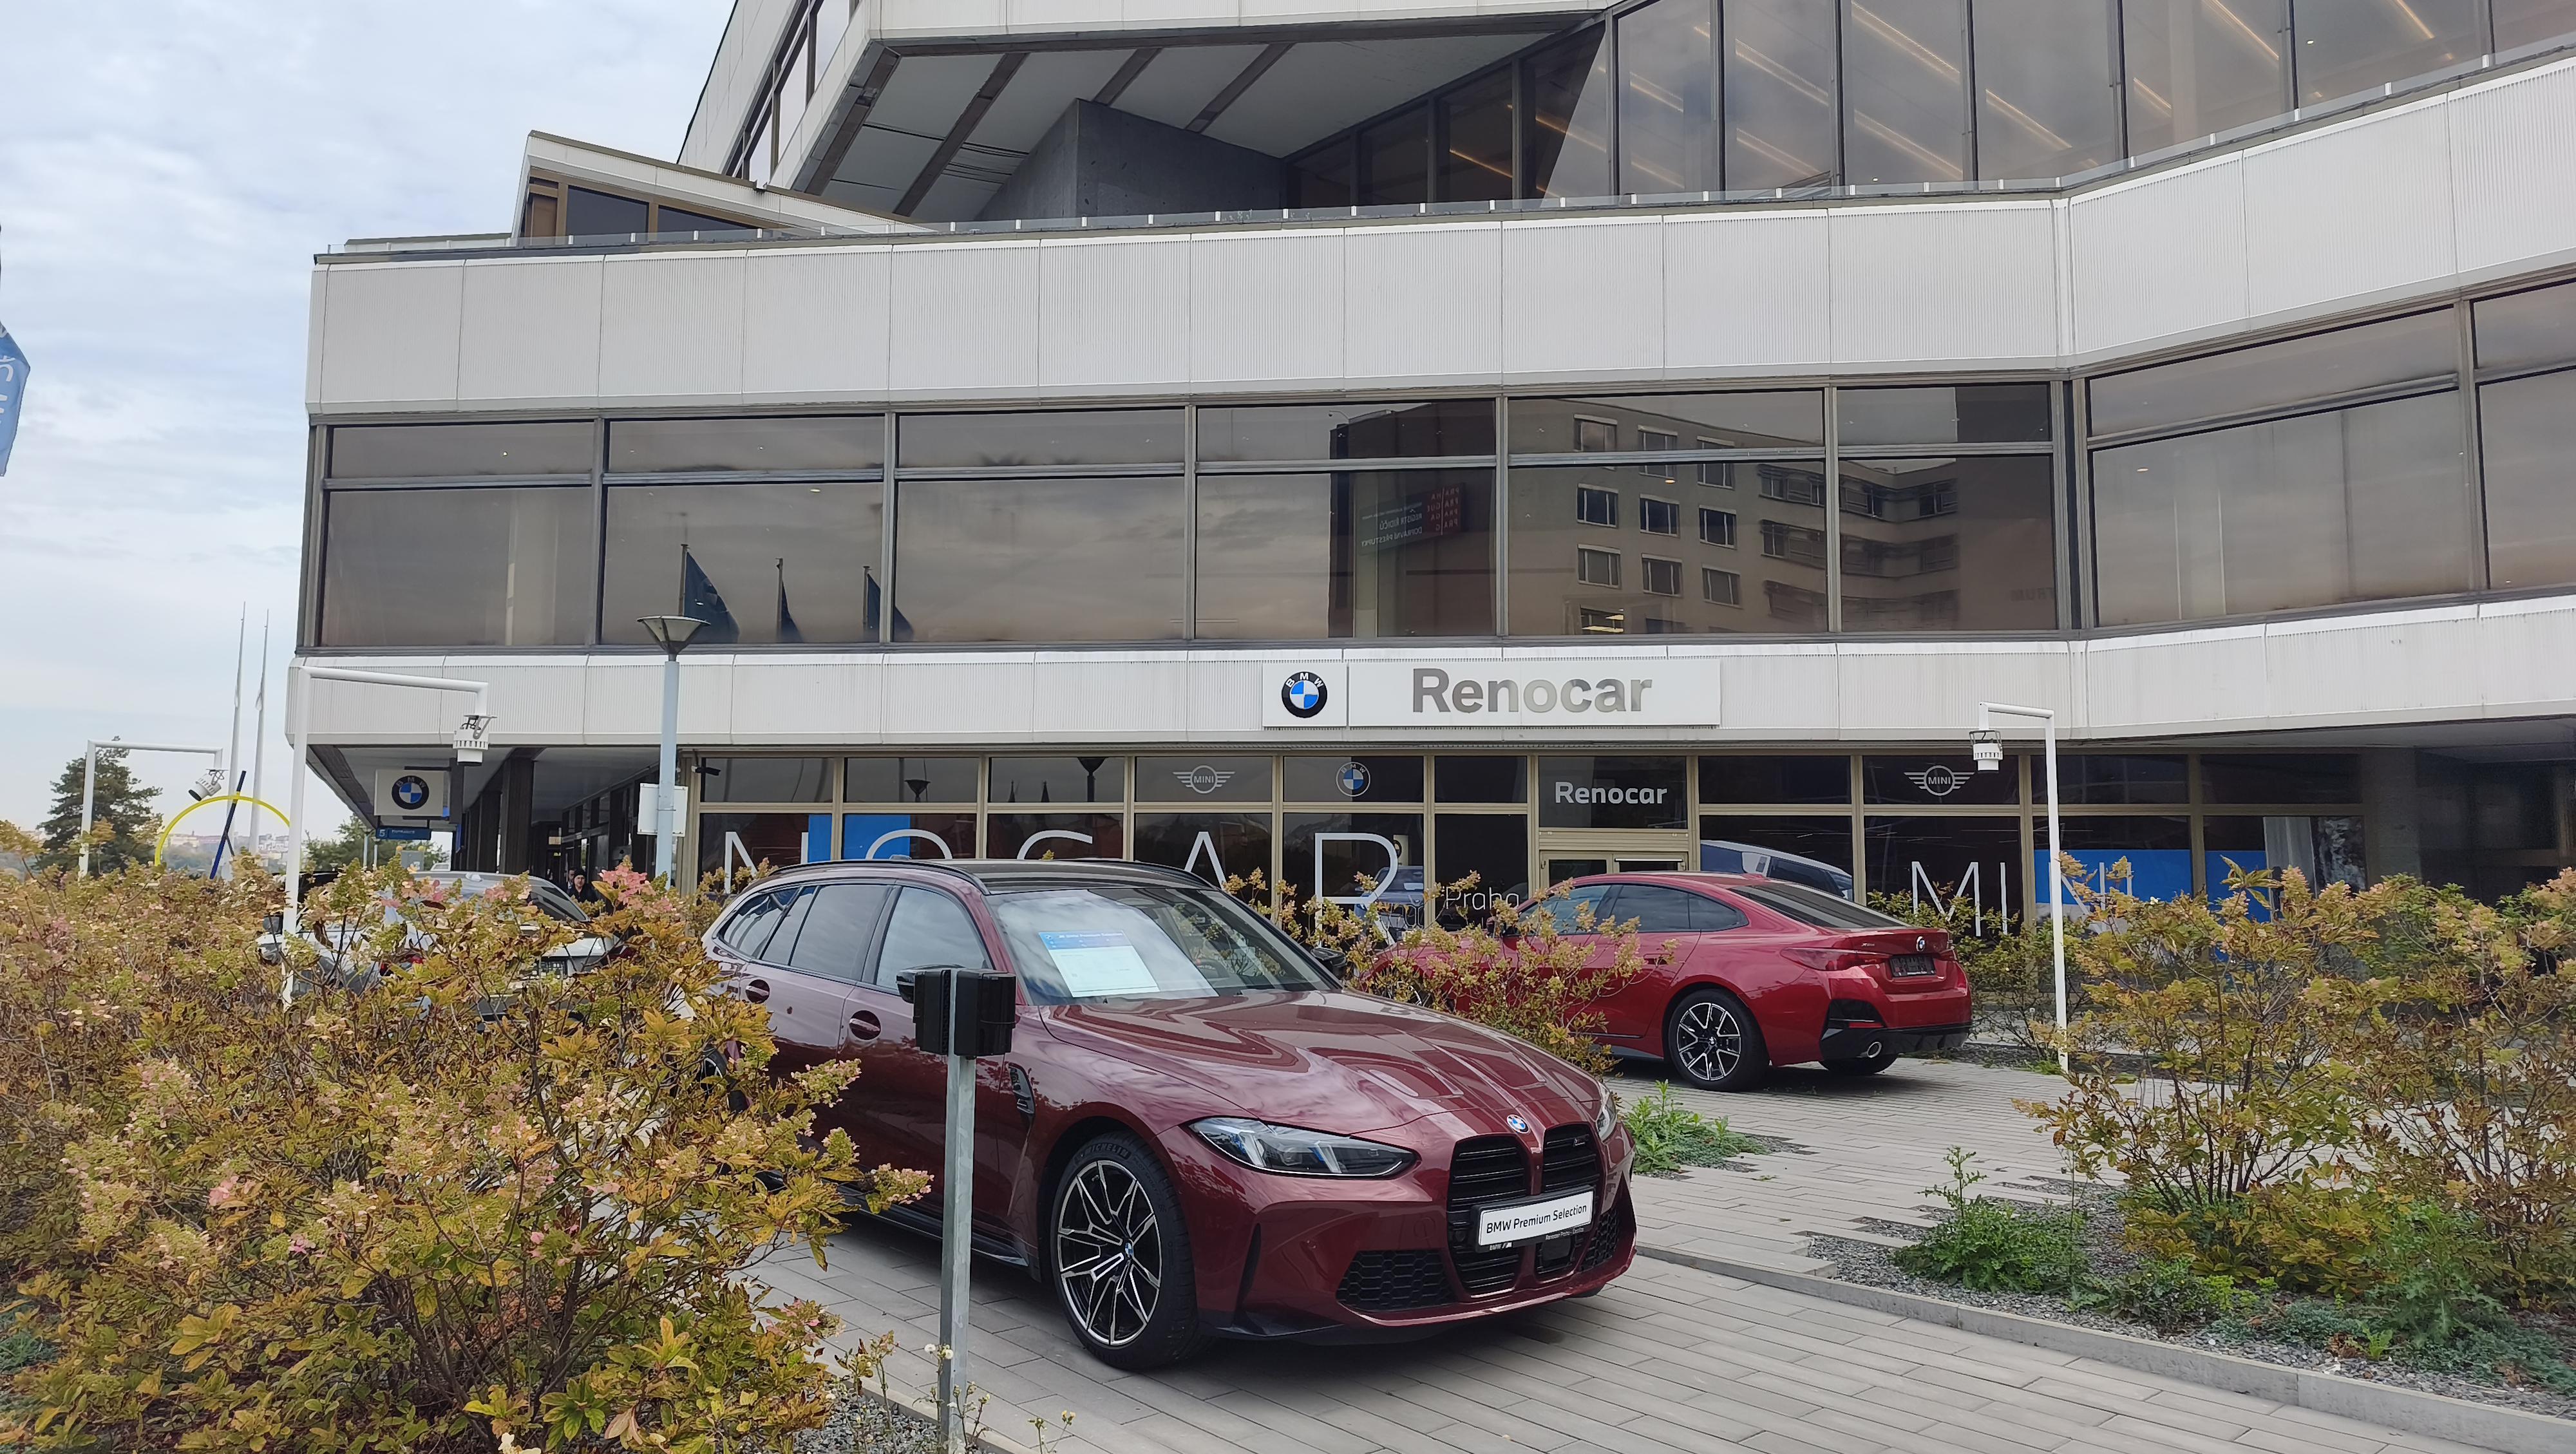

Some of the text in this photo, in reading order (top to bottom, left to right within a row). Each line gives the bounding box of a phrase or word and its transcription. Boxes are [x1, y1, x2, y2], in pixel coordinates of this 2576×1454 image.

[1285, 672, 1324, 688] BMW
[1412, 668, 1653, 714] Renocar
[1341, 764, 1367, 775] BMW
[396, 776, 426, 789] BMW
[1193, 775, 1214, 784] MINI
[1555, 781, 1668, 805] Renocar
[1445, 885, 1520, 911] Praha
[1084, 1143, 1130, 1158] MICHELIN
[1486, 1204, 1587, 1234] BMW Premium Selection
